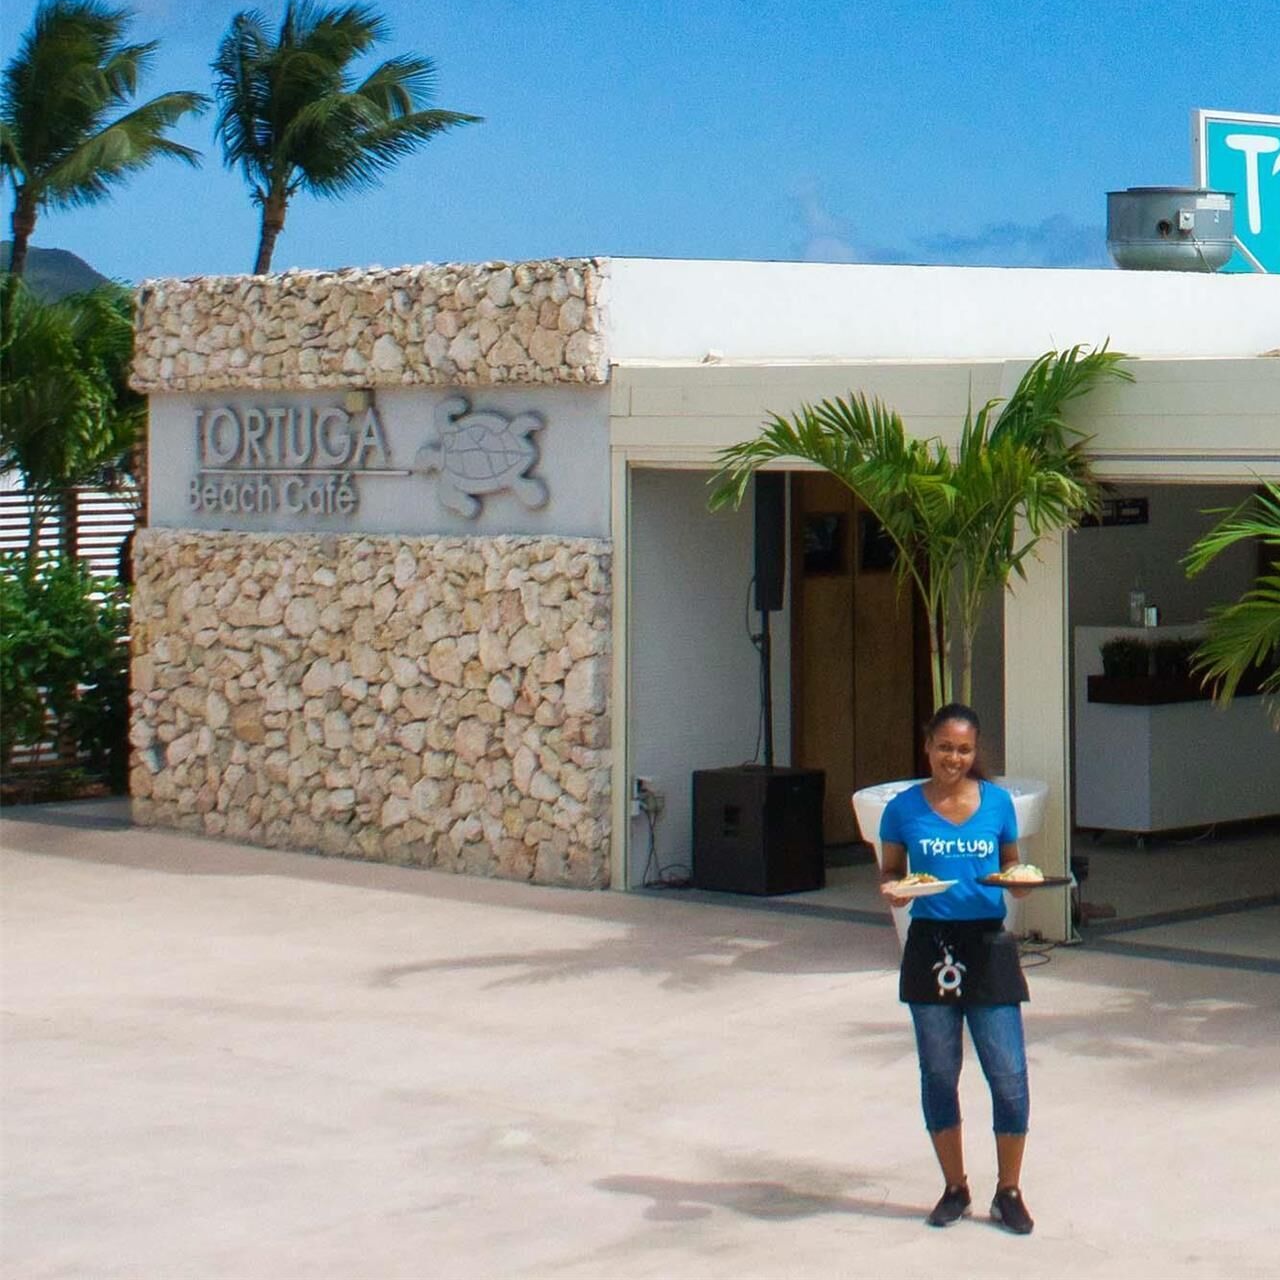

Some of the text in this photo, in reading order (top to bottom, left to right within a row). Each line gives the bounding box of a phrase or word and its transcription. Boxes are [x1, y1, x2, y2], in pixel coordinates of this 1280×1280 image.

[192, 406, 388, 466] TORTUGA
[188, 473, 357, 513] Beach Café
